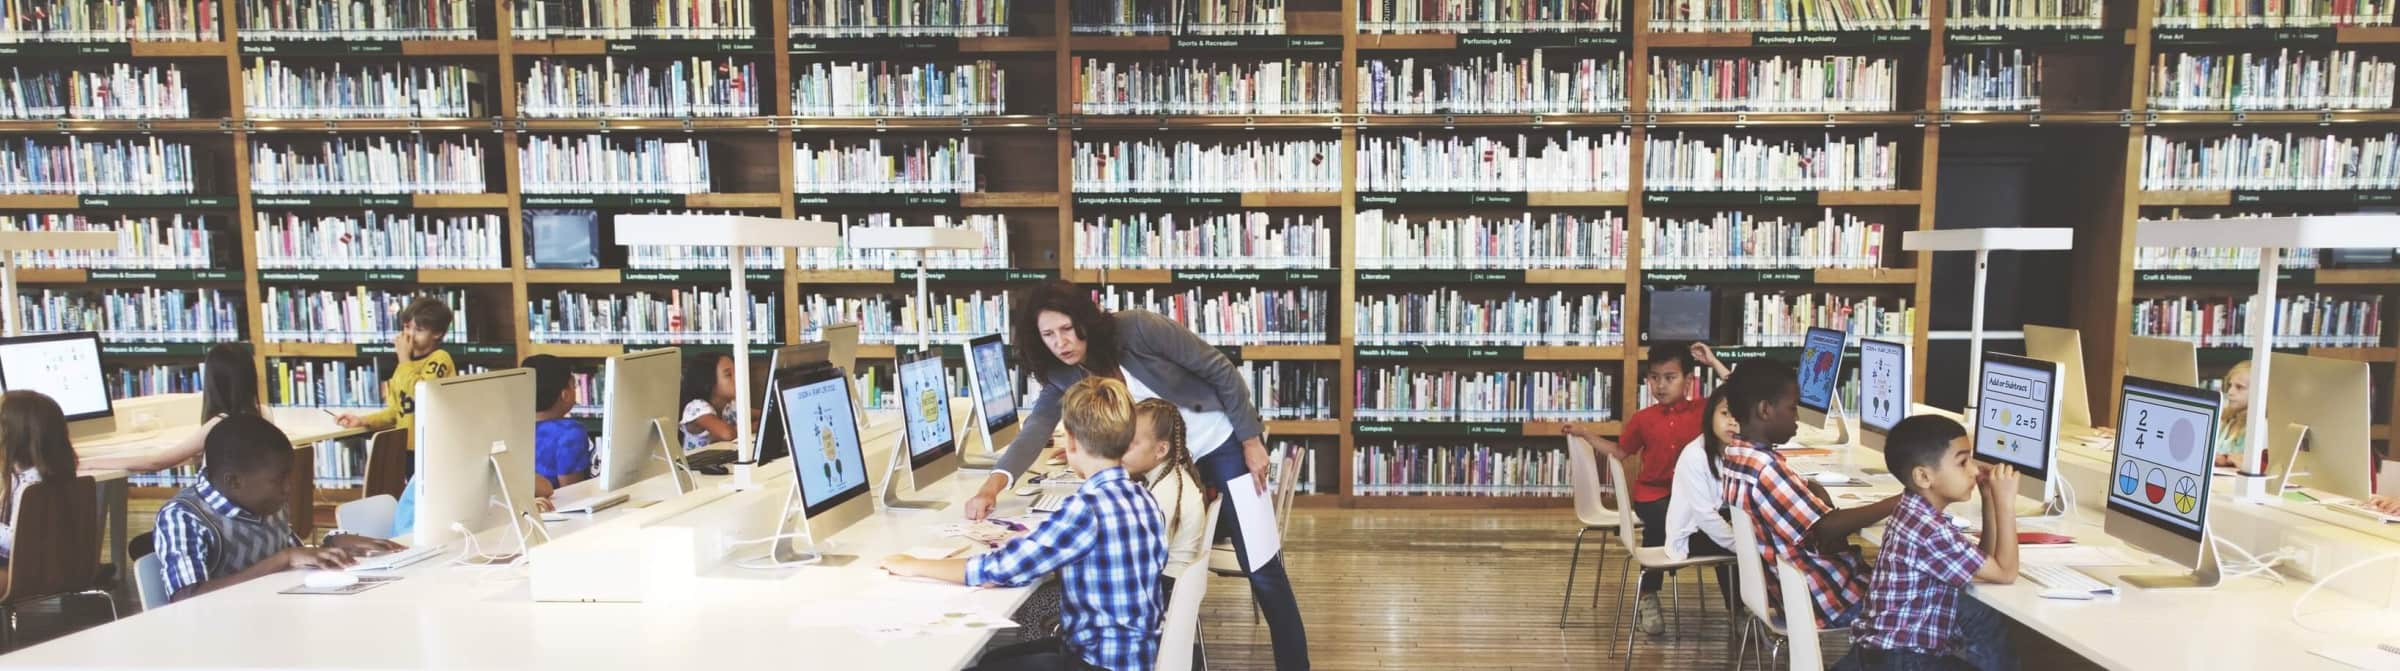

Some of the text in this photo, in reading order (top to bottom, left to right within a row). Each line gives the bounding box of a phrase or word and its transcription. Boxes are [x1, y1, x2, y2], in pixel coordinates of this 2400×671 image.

[1463, 38, 1497, 46] Performing
[1759, 36, 1796, 44] Psychology
[1648, 195, 1669, 203] Poetry
[658, 273, 679, 281] Design
[1178, 272, 1209, 280] Biography
[1216, 272, 1260, 280] Autobiography
[1647, 273, 1687, 281] Photography
[426, 361, 448, 378] 36
[2005, 380, 2027, 392] Subtract
[1991, 409, 1998, 420] 7
[2139, 409, 2148, 426] 2
[2136, 433, 2144, 450] 4
